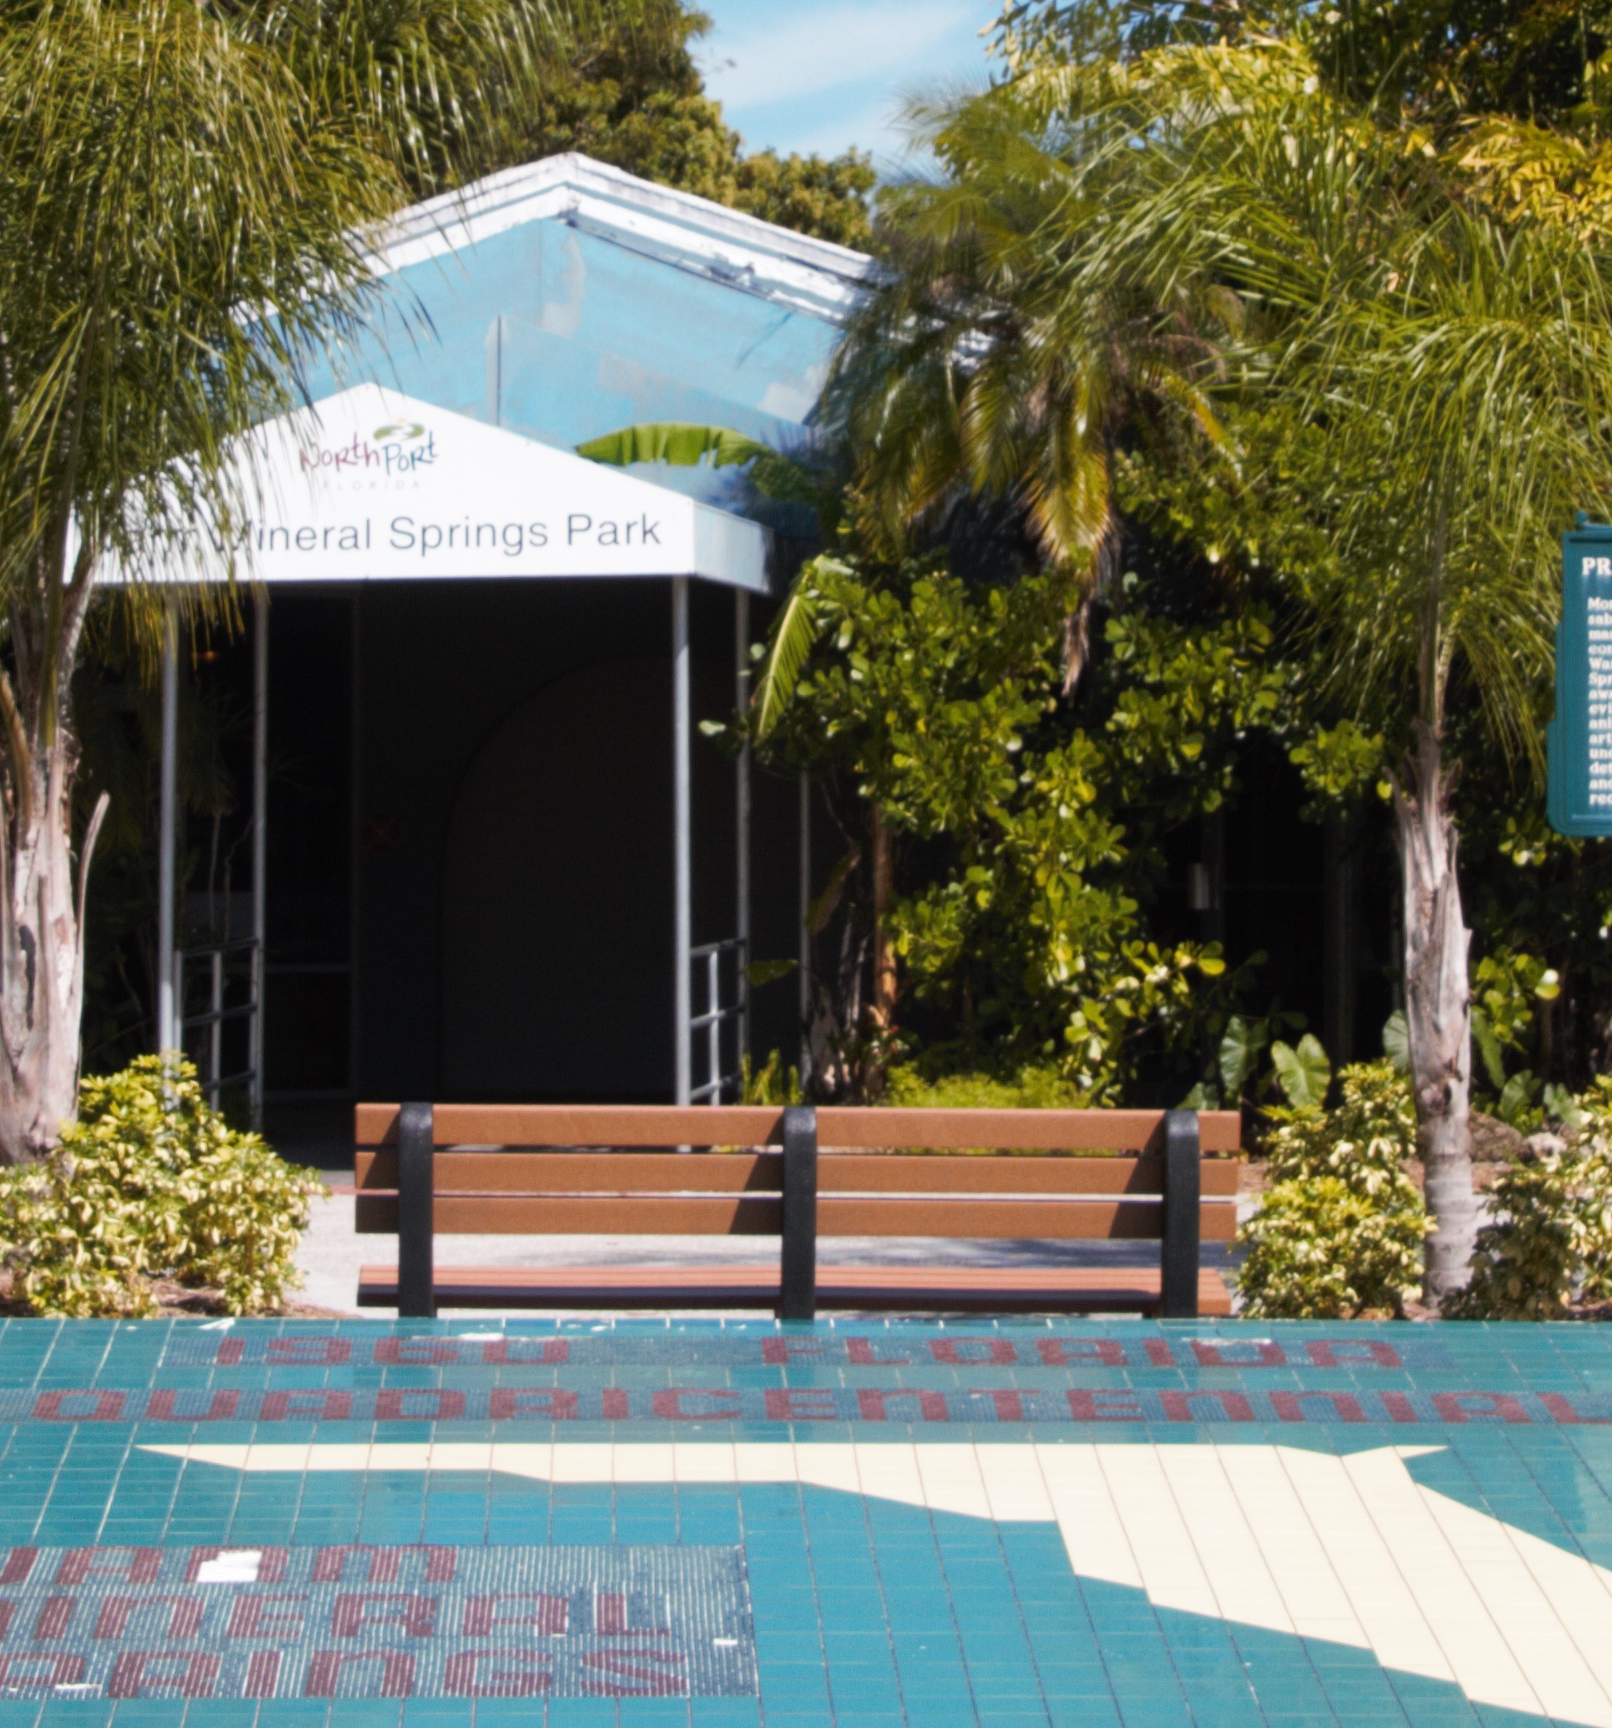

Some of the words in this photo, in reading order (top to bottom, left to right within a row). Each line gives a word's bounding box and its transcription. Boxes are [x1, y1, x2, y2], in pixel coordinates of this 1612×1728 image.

[299, 431, 380, 472] North
[382, 430, 439, 476] Port
[322, 479, 421, 491] FLORIDA
[389, 515, 549, 557] Springs
[566, 512, 661, 547] Park
[760, 1336, 1405, 1369] FLORIDA
